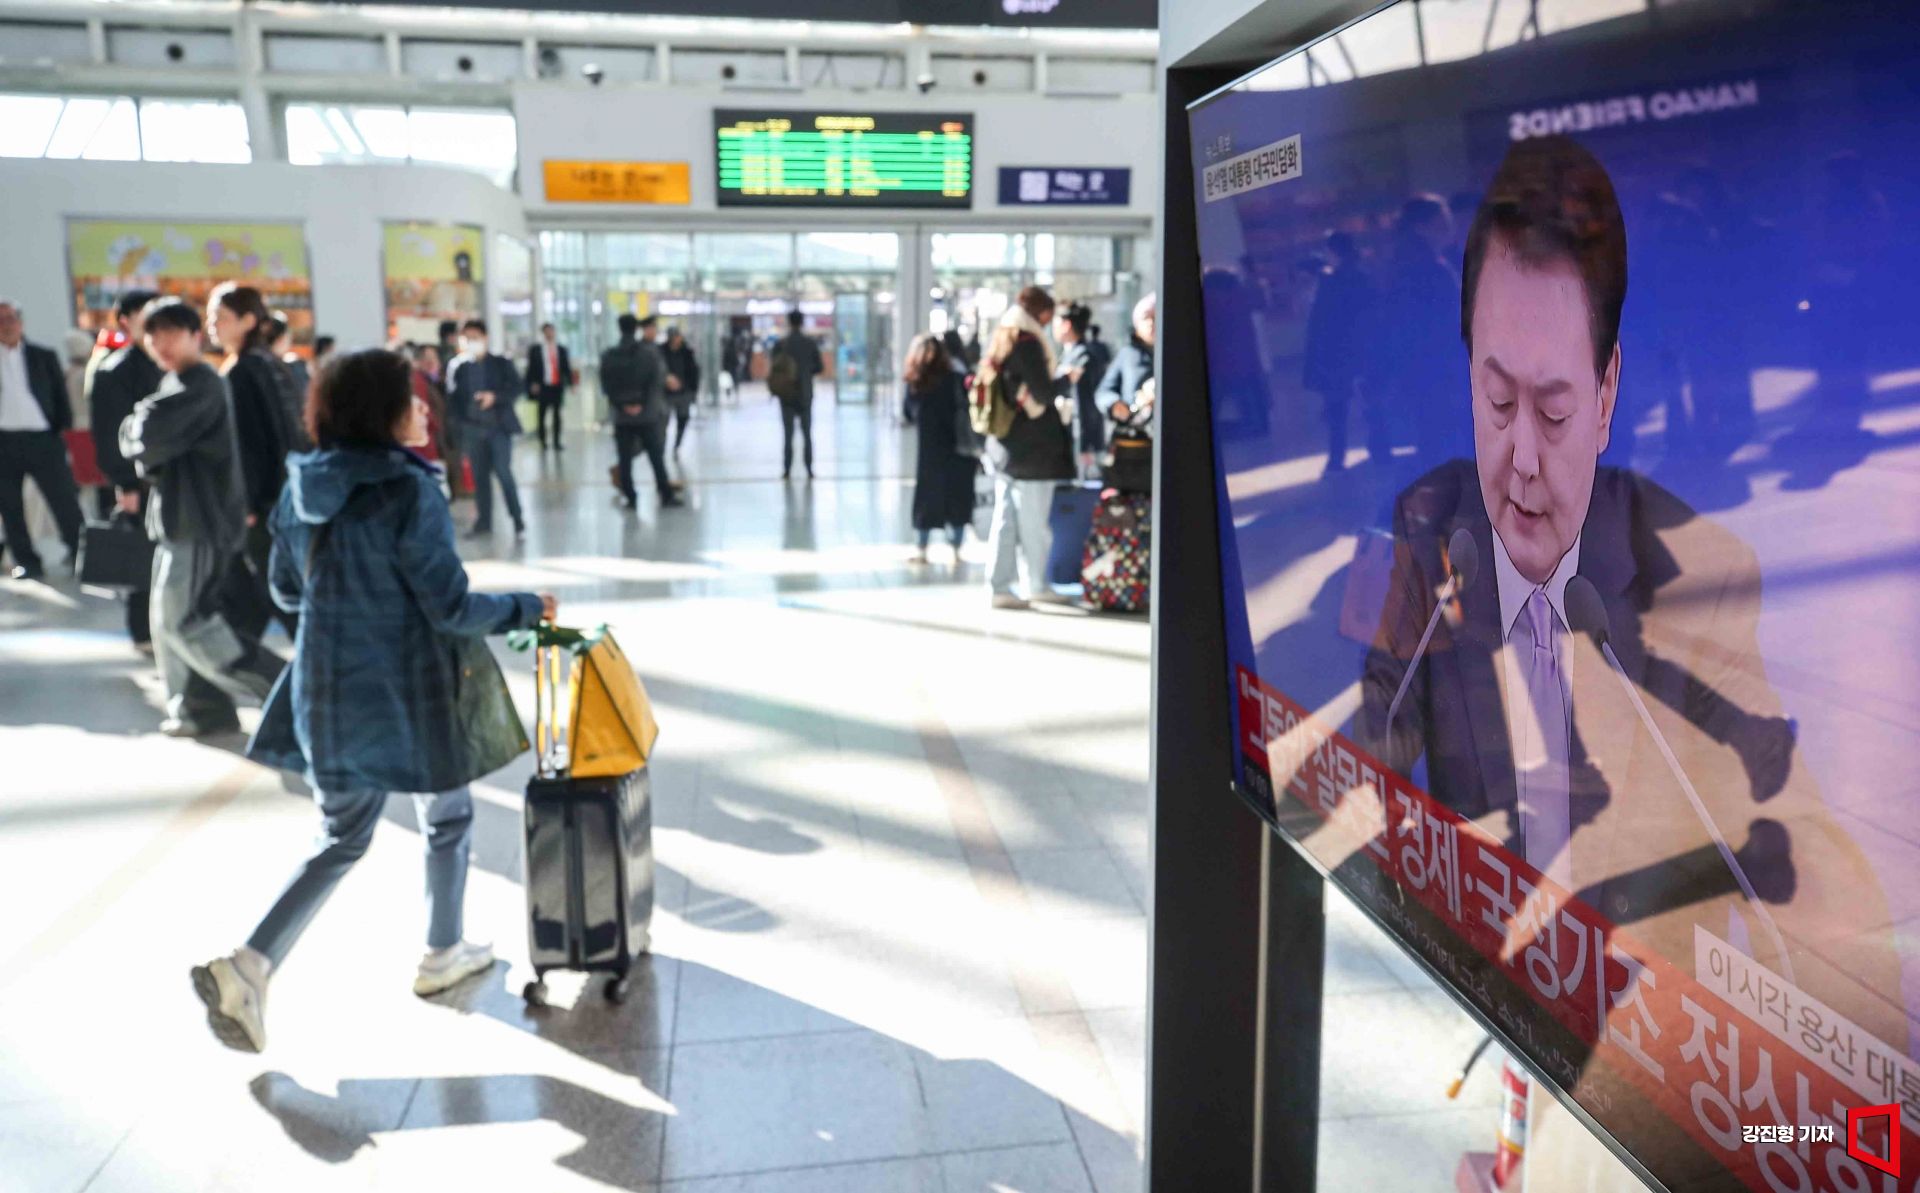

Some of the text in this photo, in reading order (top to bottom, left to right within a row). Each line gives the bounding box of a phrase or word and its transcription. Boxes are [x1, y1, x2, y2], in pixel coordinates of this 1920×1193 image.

[1206, 141, 1298, 197] 윤석열 대통령 대국민담화
[1708, 947, 1733, 994] 이
[1738, 968, 1793, 1033] 시각
[1797, 1006, 1857, 1077] 용산
